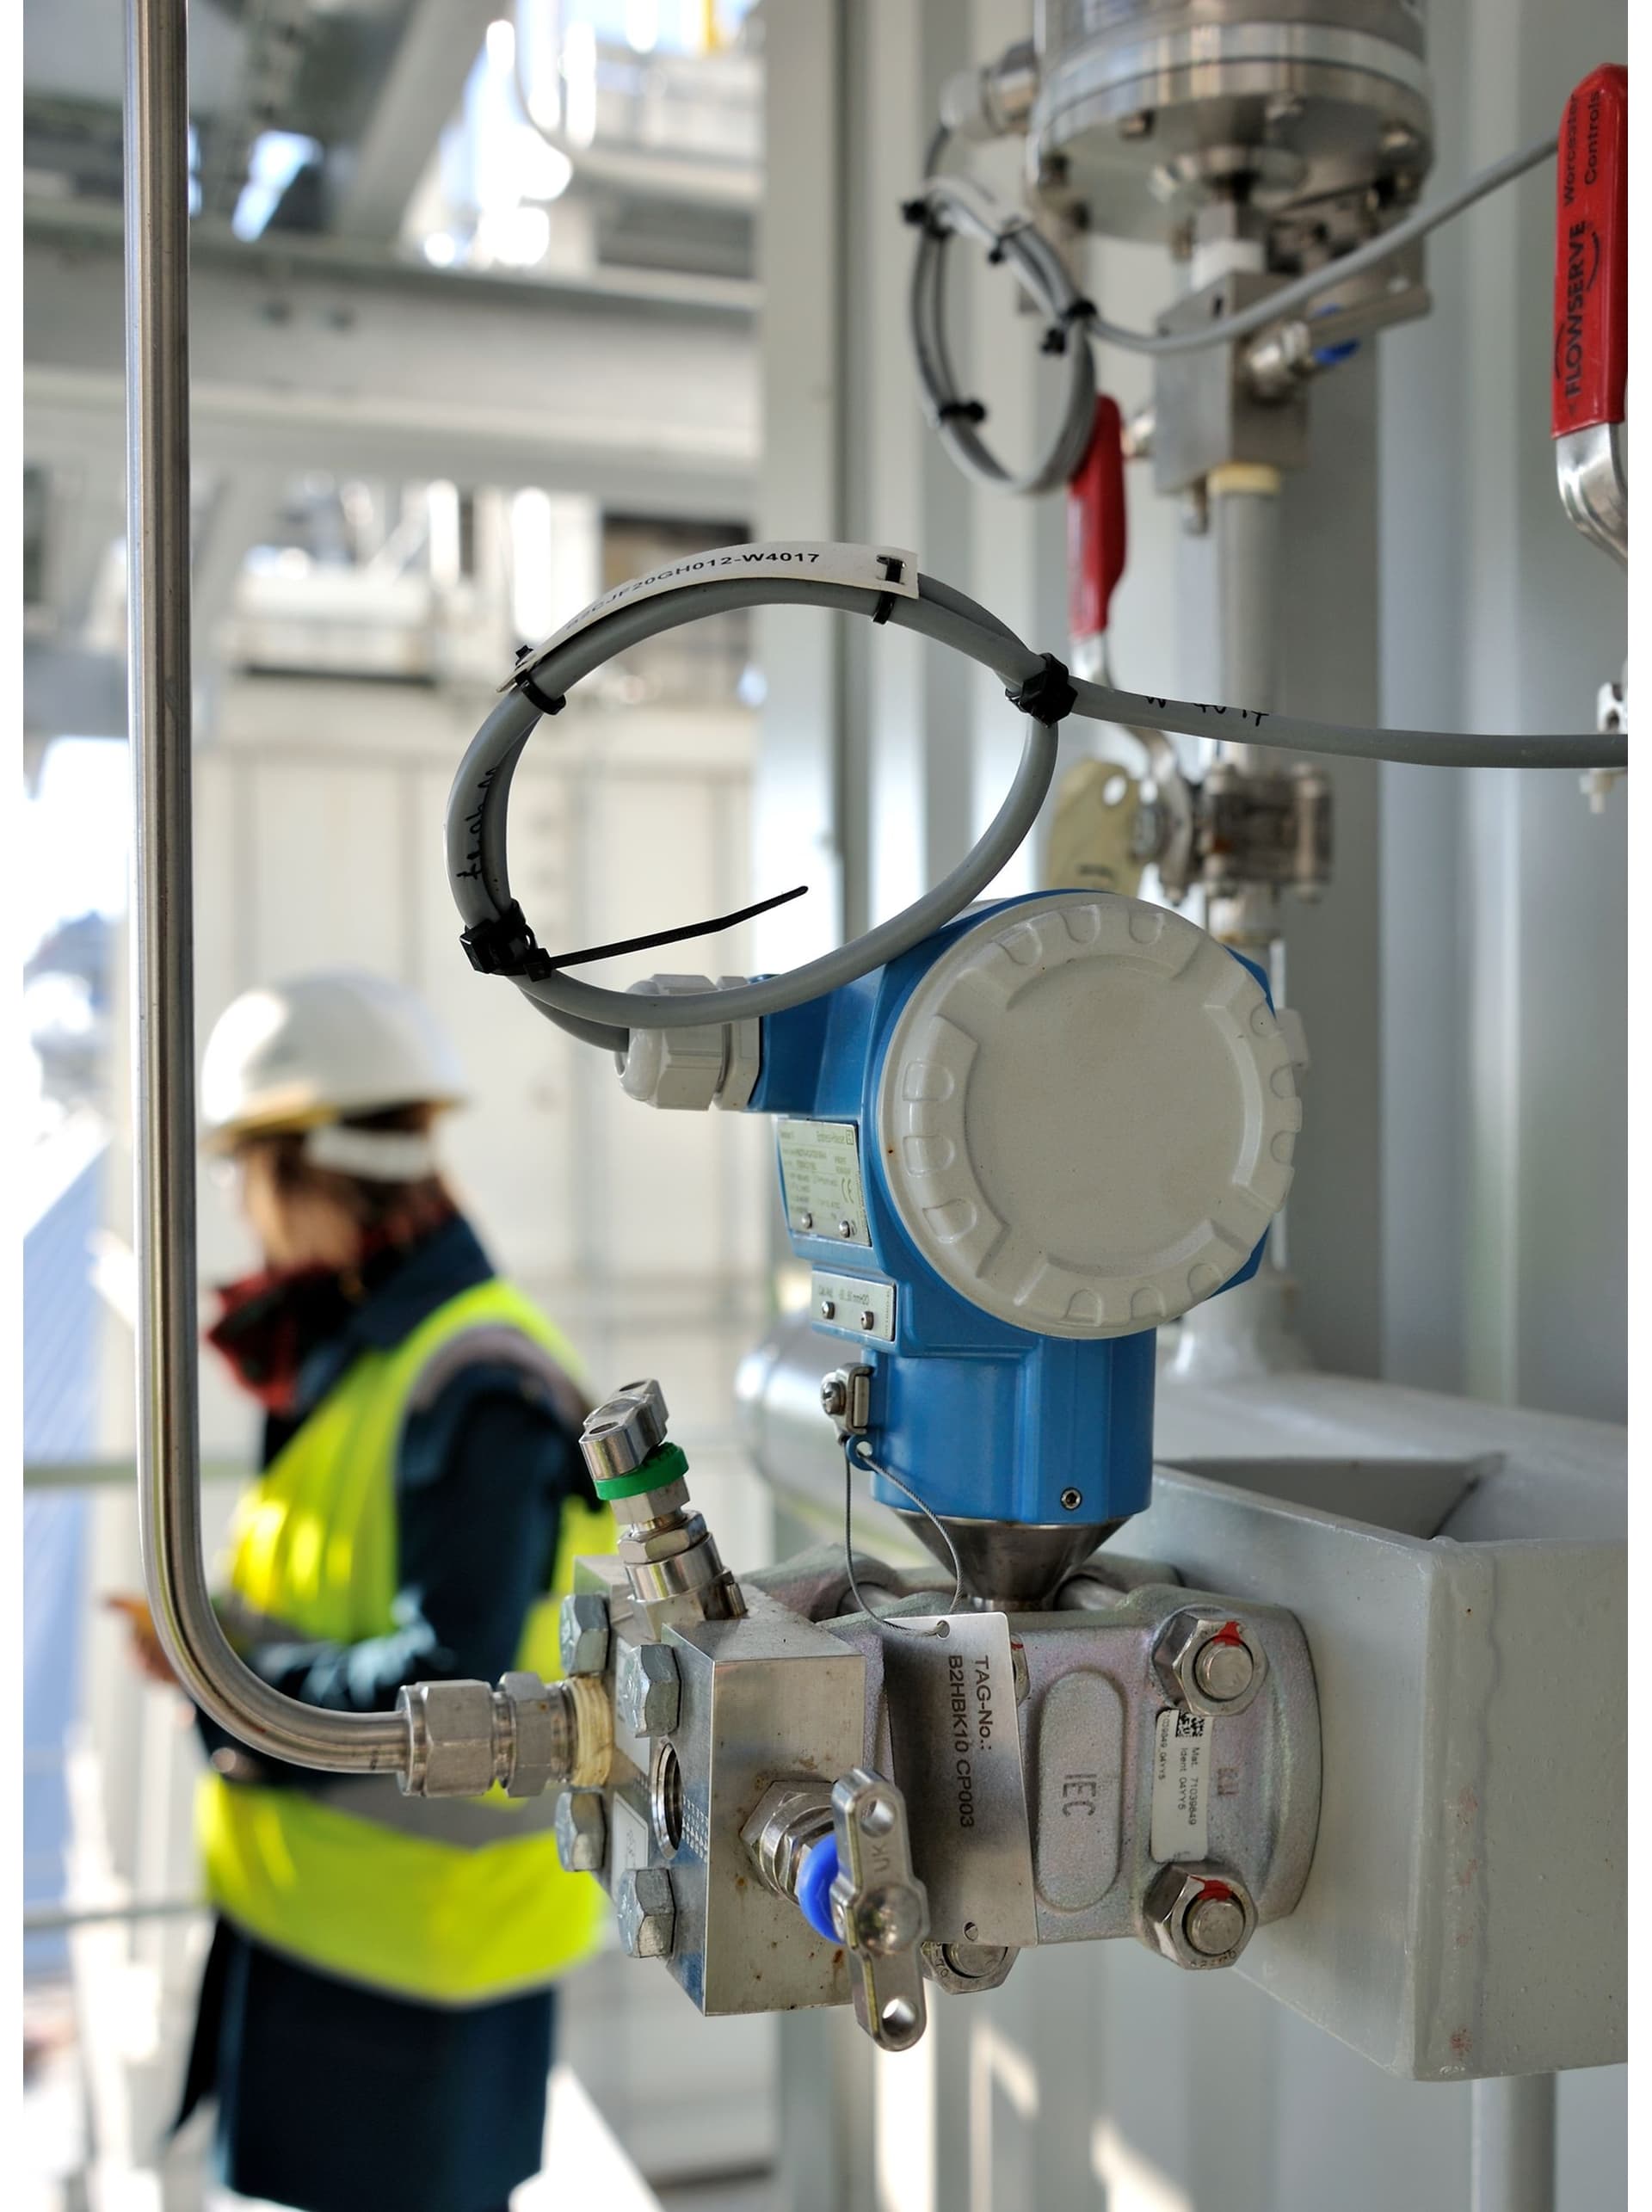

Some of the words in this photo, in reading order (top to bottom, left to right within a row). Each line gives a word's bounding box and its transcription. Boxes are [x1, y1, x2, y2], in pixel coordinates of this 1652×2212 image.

[1563, 93, 1578, 207] Worcester
[1584, 89, 1600, 186] Controls
[1564, 220, 1587, 397] FLOWSERVE
[948, 1654, 970, 1753] B2HBK10
[975, 1654, 994, 1751] TAG-No.:
[956, 1759, 975, 1829] CP003
[1062, 1774, 1097, 1817] IEC
